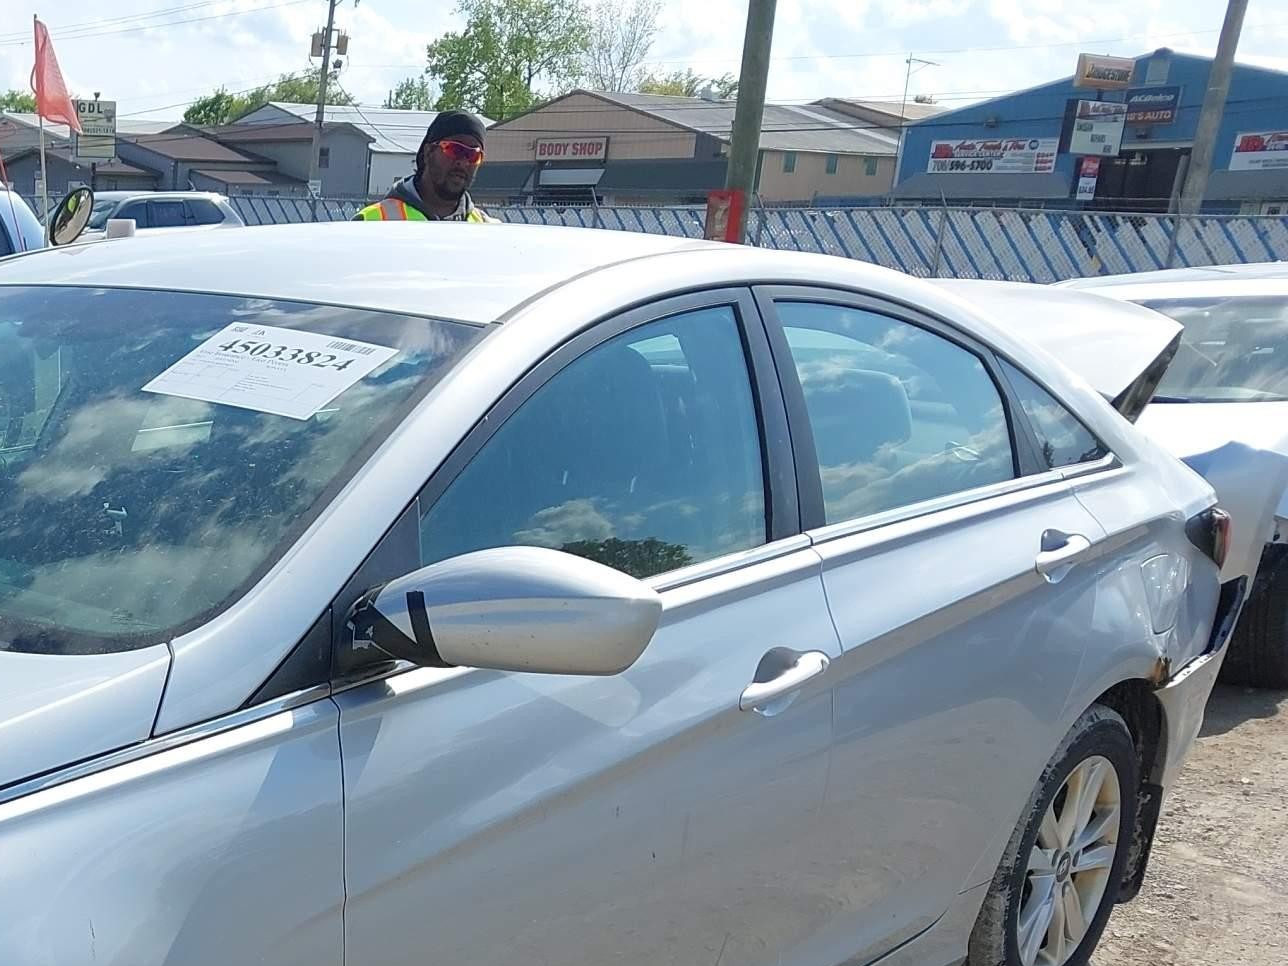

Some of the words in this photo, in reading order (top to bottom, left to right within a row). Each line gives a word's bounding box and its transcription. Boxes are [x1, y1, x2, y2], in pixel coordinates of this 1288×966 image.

[79, 102, 103, 114] GDL
[1144, 110, 1172, 121] AUTO
[539, 143, 569, 156] BODY
[572, 142, 602, 156] SHOP
[217, 338, 357, 371] 45033824
